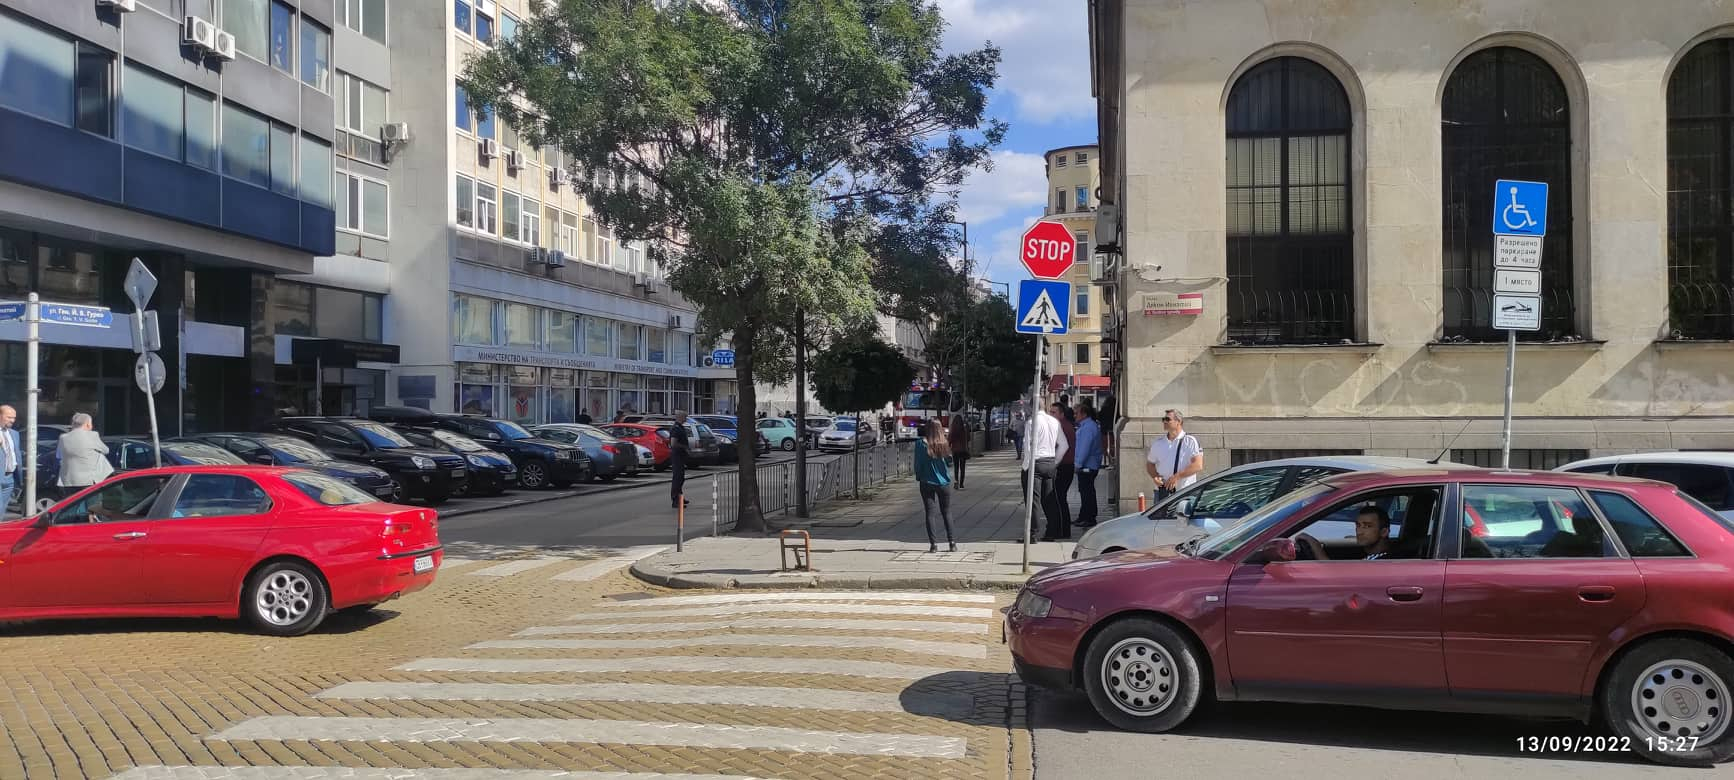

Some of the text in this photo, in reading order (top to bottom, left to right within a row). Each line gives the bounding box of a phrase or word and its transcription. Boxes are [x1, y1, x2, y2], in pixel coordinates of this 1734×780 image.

[1500, 238, 1538, 247] Разрешено
[1026, 238, 1071, 261] STOP
[478, 351, 521, 362] МИНИСТЕРСТВО
[521, 354, 529, 362] НА
